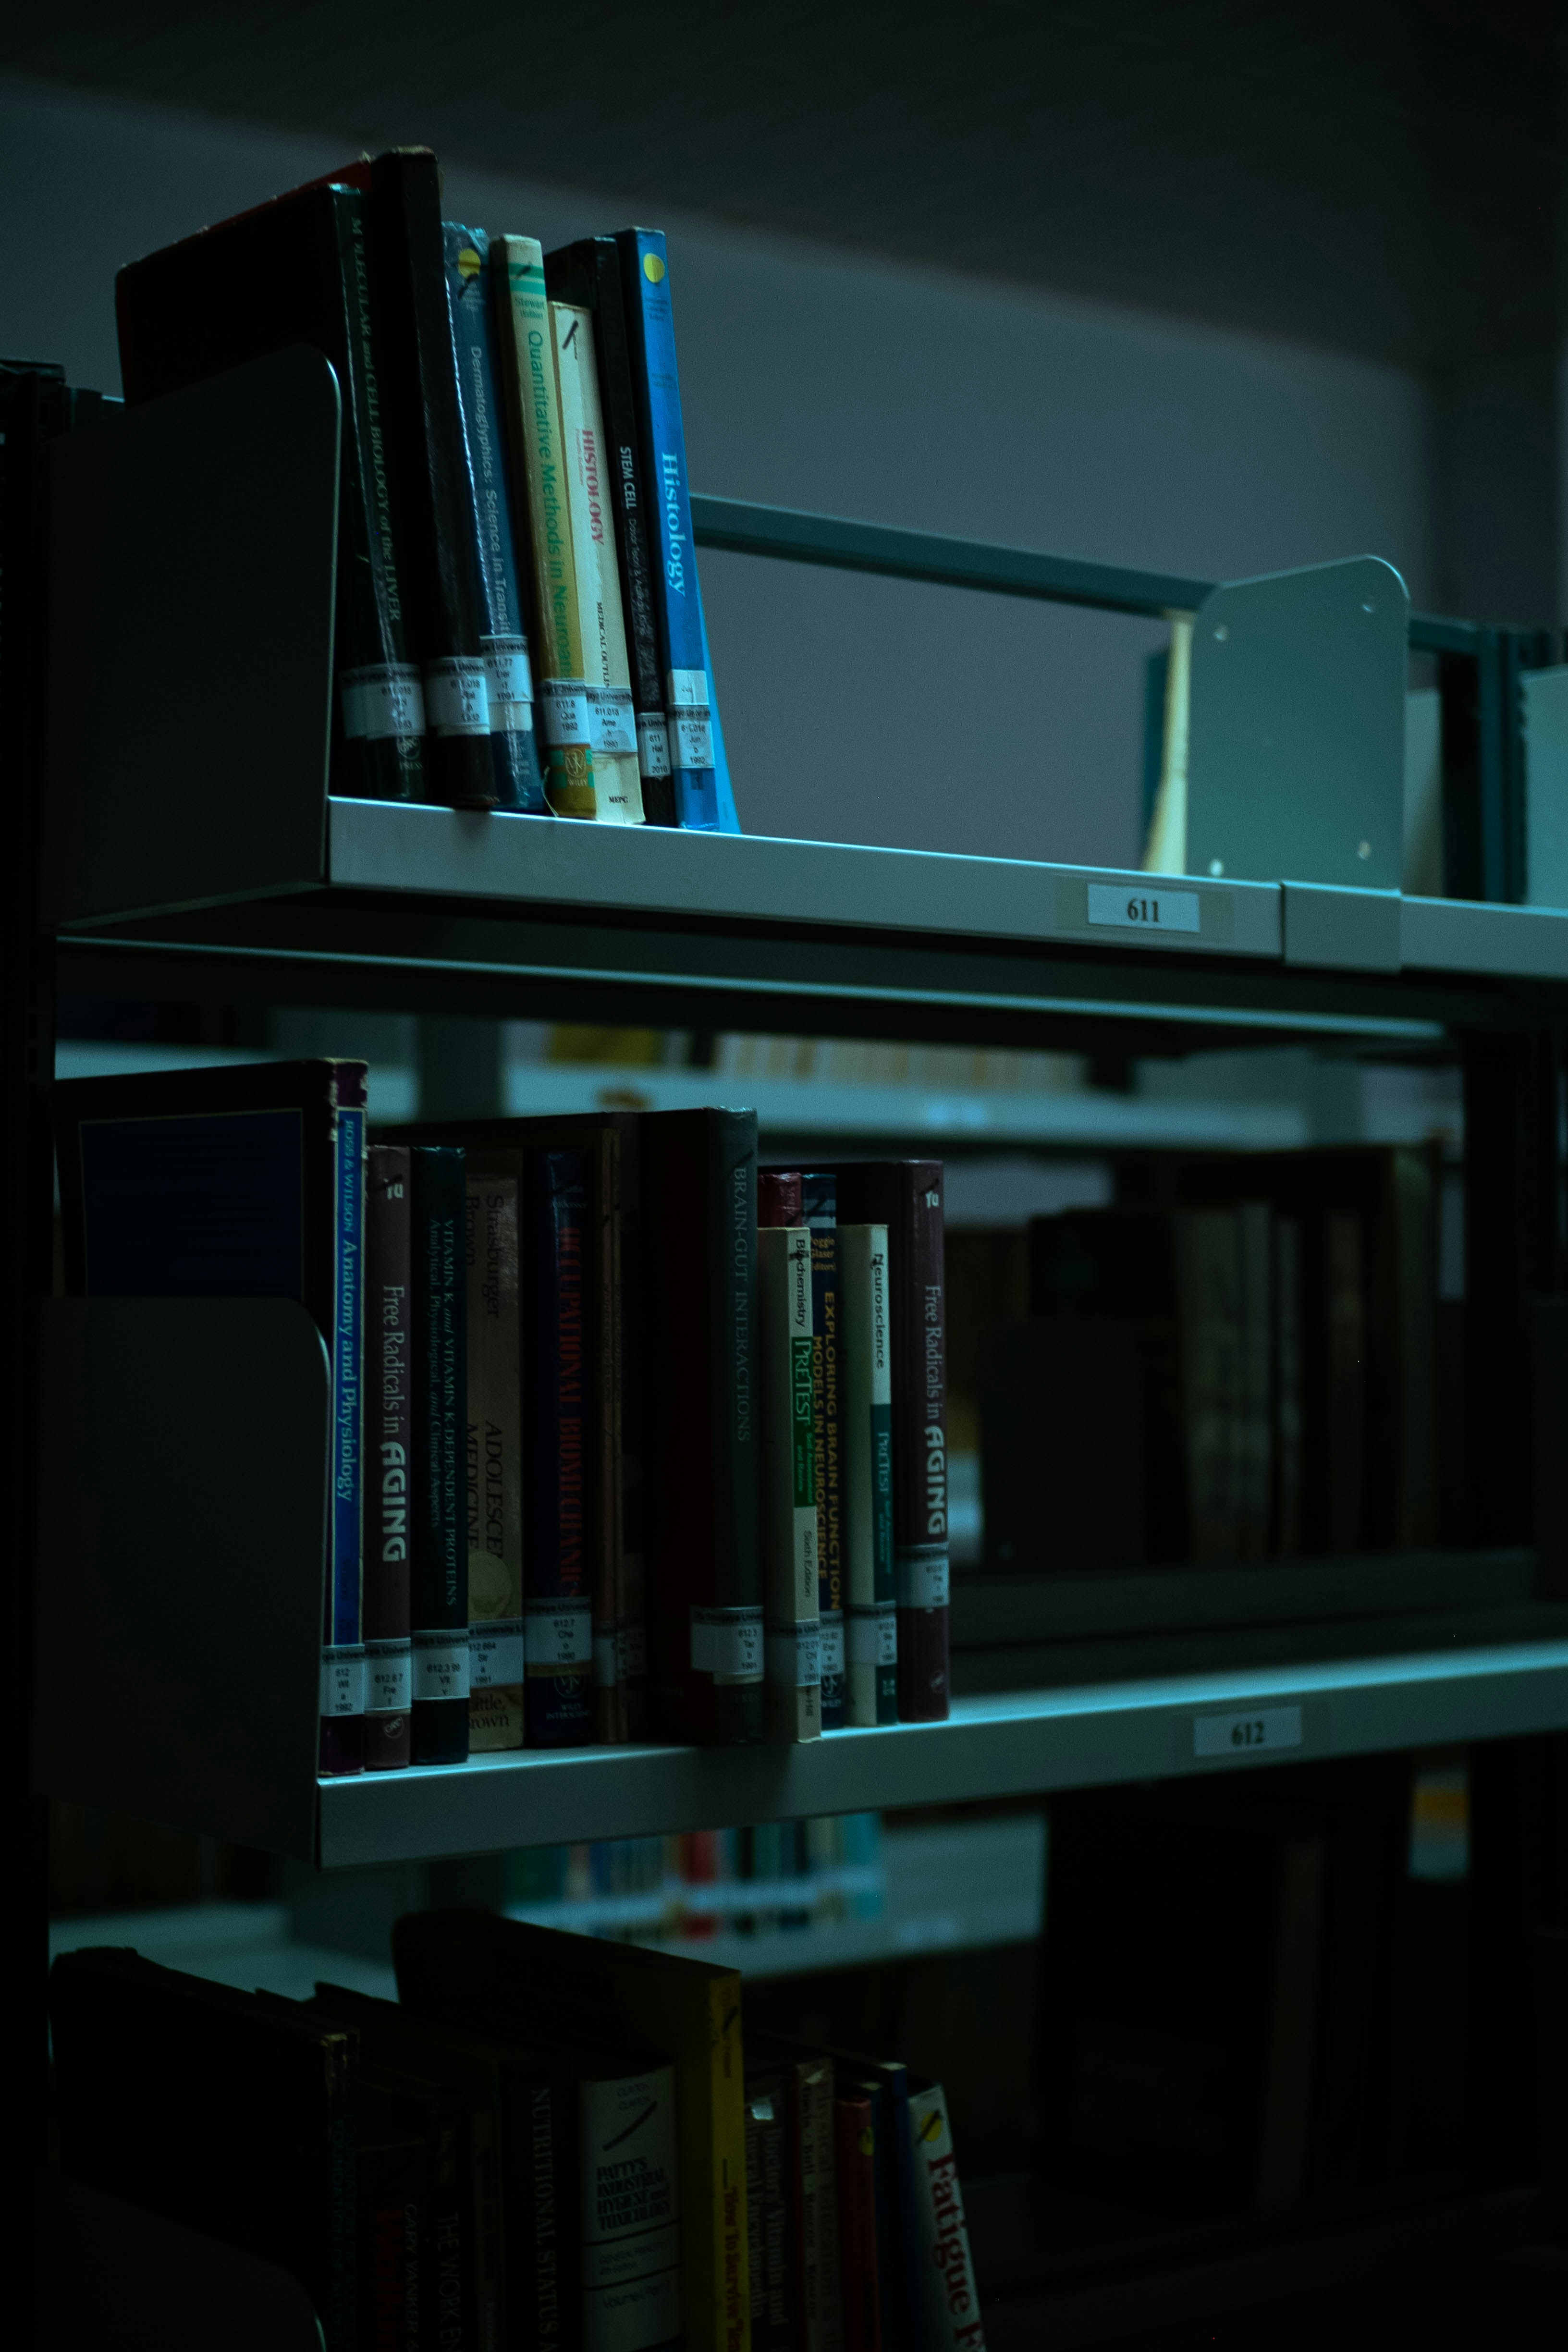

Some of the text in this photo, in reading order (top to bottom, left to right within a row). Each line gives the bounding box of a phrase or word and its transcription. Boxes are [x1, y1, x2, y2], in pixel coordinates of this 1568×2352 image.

[363, 340, 375, 370] and
[364, 372, 378, 423] CELL
[470, 346, 494, 484] Dermatoglyphics:
[528, 331, 553, 460] Quantitative
[370, 426, 390, 512] BIOLOGY
[582, 430, 604, 545] HISTOLOGY
[619, 447, 638, 510] STEM CELL
[380, 514, 392, 534] of
[486, 489, 501, 552] Science
[541, 464, 564, 554] Methods
[661, 452, 687, 598] Histology
[380, 537, 394, 560] the
[492, 558, 504, 572] in
[550, 561, 565, 577] in
[384, 564, 402, 622] LIVER
[597, 601, 607, 649] MEDICAL
[1127, 898, 1159, 922] 611
[343, 1120, 355, 1234] ROSS & WILSON
[429, 1218, 442, 1291] Analytical,
[480, 1194, 505, 1319] Strasburger
[558, 1226, 583, 1409] OCCUPATIONAL
[733, 1167, 751, 1443] BRAIN-GUT INTERACTIONS
[872, 1253, 886, 1369] Neuroscience
[924, 1285, 942, 1323] Free
[336, 1239, 357, 1502] Anatomy and Physiology
[426, 1295, 442, 1388] Physiological,
[823, 1291, 837, 1417] EXPLORING
[925, 1326, 943, 1399] Radicals
[378, 1285, 407, 1562] Free Radicals in AGING
[429, 1391, 442, 1418] and
[442, 1219, 458, 1606] VITAMIN K and VITAMIN K-DEPENDENT PROTEINS
[926, 1402, 943, 1420] in
[429, 1421, 441, 1473] Clinical
[812, 1335, 828, 1580] MODELS IN NEUROSCIENCE
[826, 1422, 838, 1488] BRAIN
[923, 1425, 945, 1535] AGING
[466, 1422, 478, 1550] MEDICINE
[804, 1531, 813, 1598] Sixth Edition
[828, 1494, 842, 1610] FUNCTION
[469, 1716, 510, 1729] rown
[474, 1692, 505, 1711] ittle,
[1231, 1721, 1265, 1746] 612
[596, 2156, 648, 2182] PATTY'S
[596, 2168, 666, 2199] INDUSTRIAL
[766, 2126, 785, 2207] Doctors'
[404, 2203, 418, 2255] GARY
[437, 2211, 461, 2253] THE
[530, 2086, 558, 2336] NUTRITIONAL STATUS
[598, 2189, 650, 2215] HYGIENE
[598, 2200, 672, 2232] TOXICOLOGY
[928, 2151, 972, 2315] Fatigue
[768, 2208, 788, 2285] Vitamin
[405, 2259, 420, 2334] YANKER
[438, 2254, 462, 2324] WORK
[725, 2252, 742, 2320] Survive
[769, 2289, 790, 2326] and
